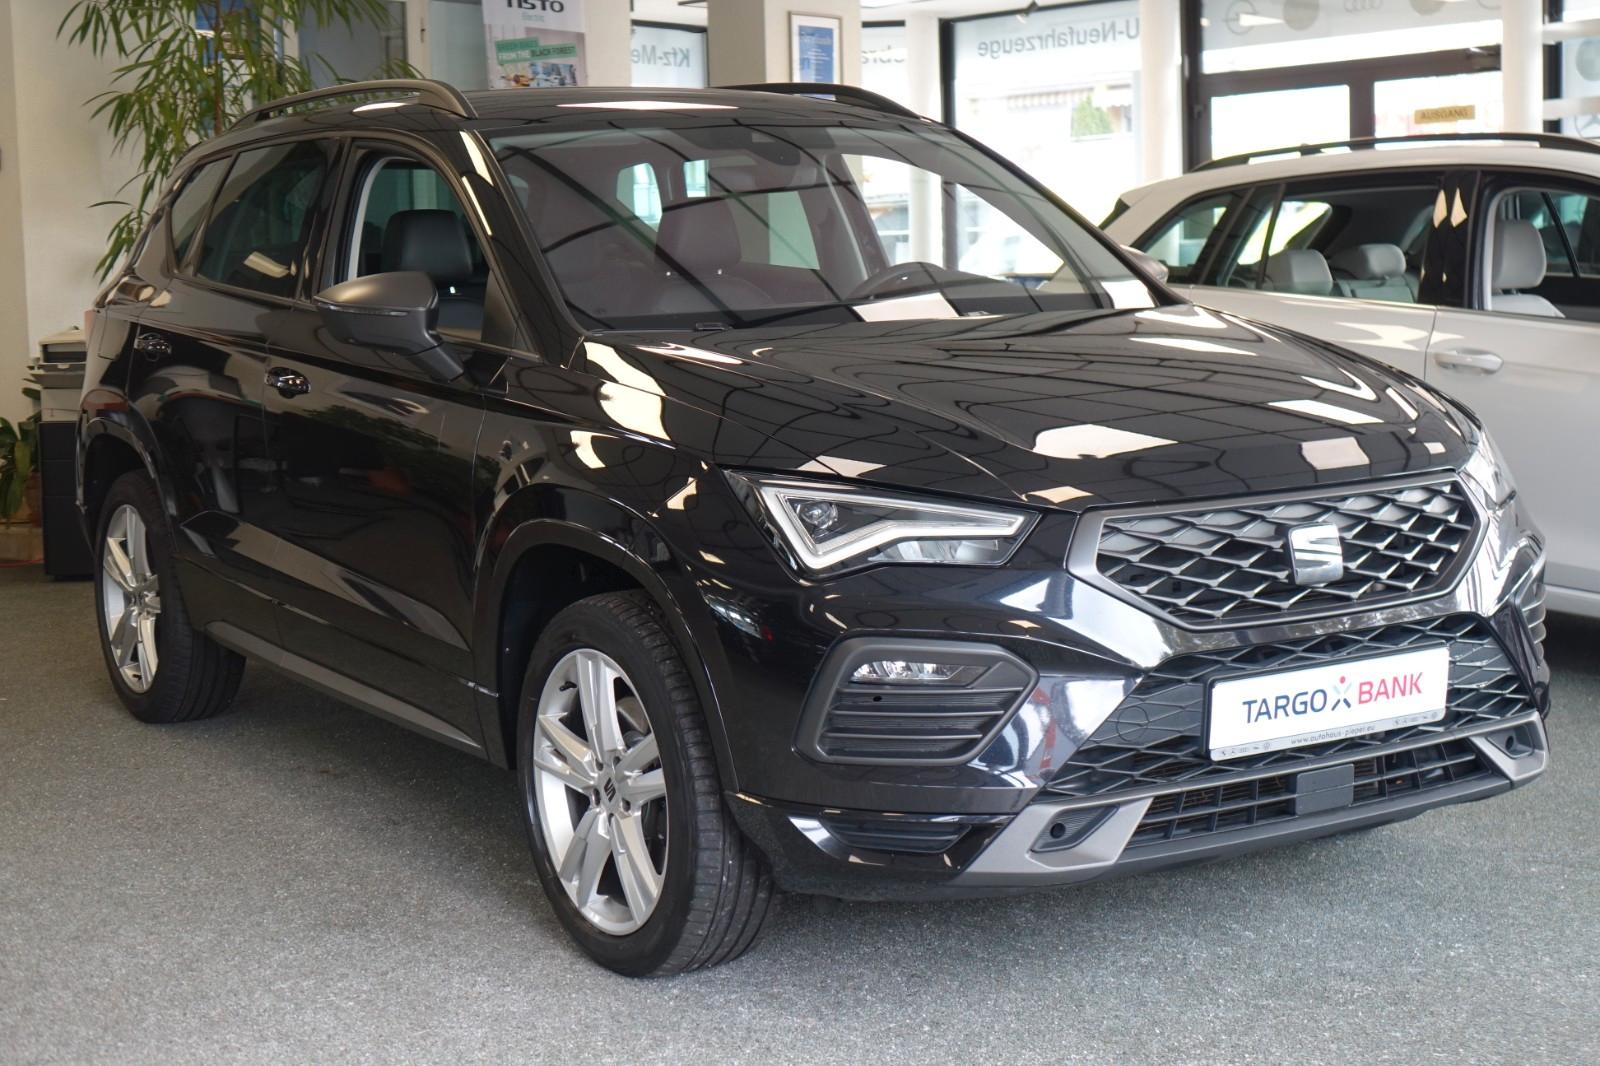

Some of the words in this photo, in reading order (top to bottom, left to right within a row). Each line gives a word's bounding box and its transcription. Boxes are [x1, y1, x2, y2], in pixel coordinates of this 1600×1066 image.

[1420, 107, 1469, 120] AUSGANG
[1242, 688, 1328, 724] TARGO
[1358, 671, 1424, 705] BANK
